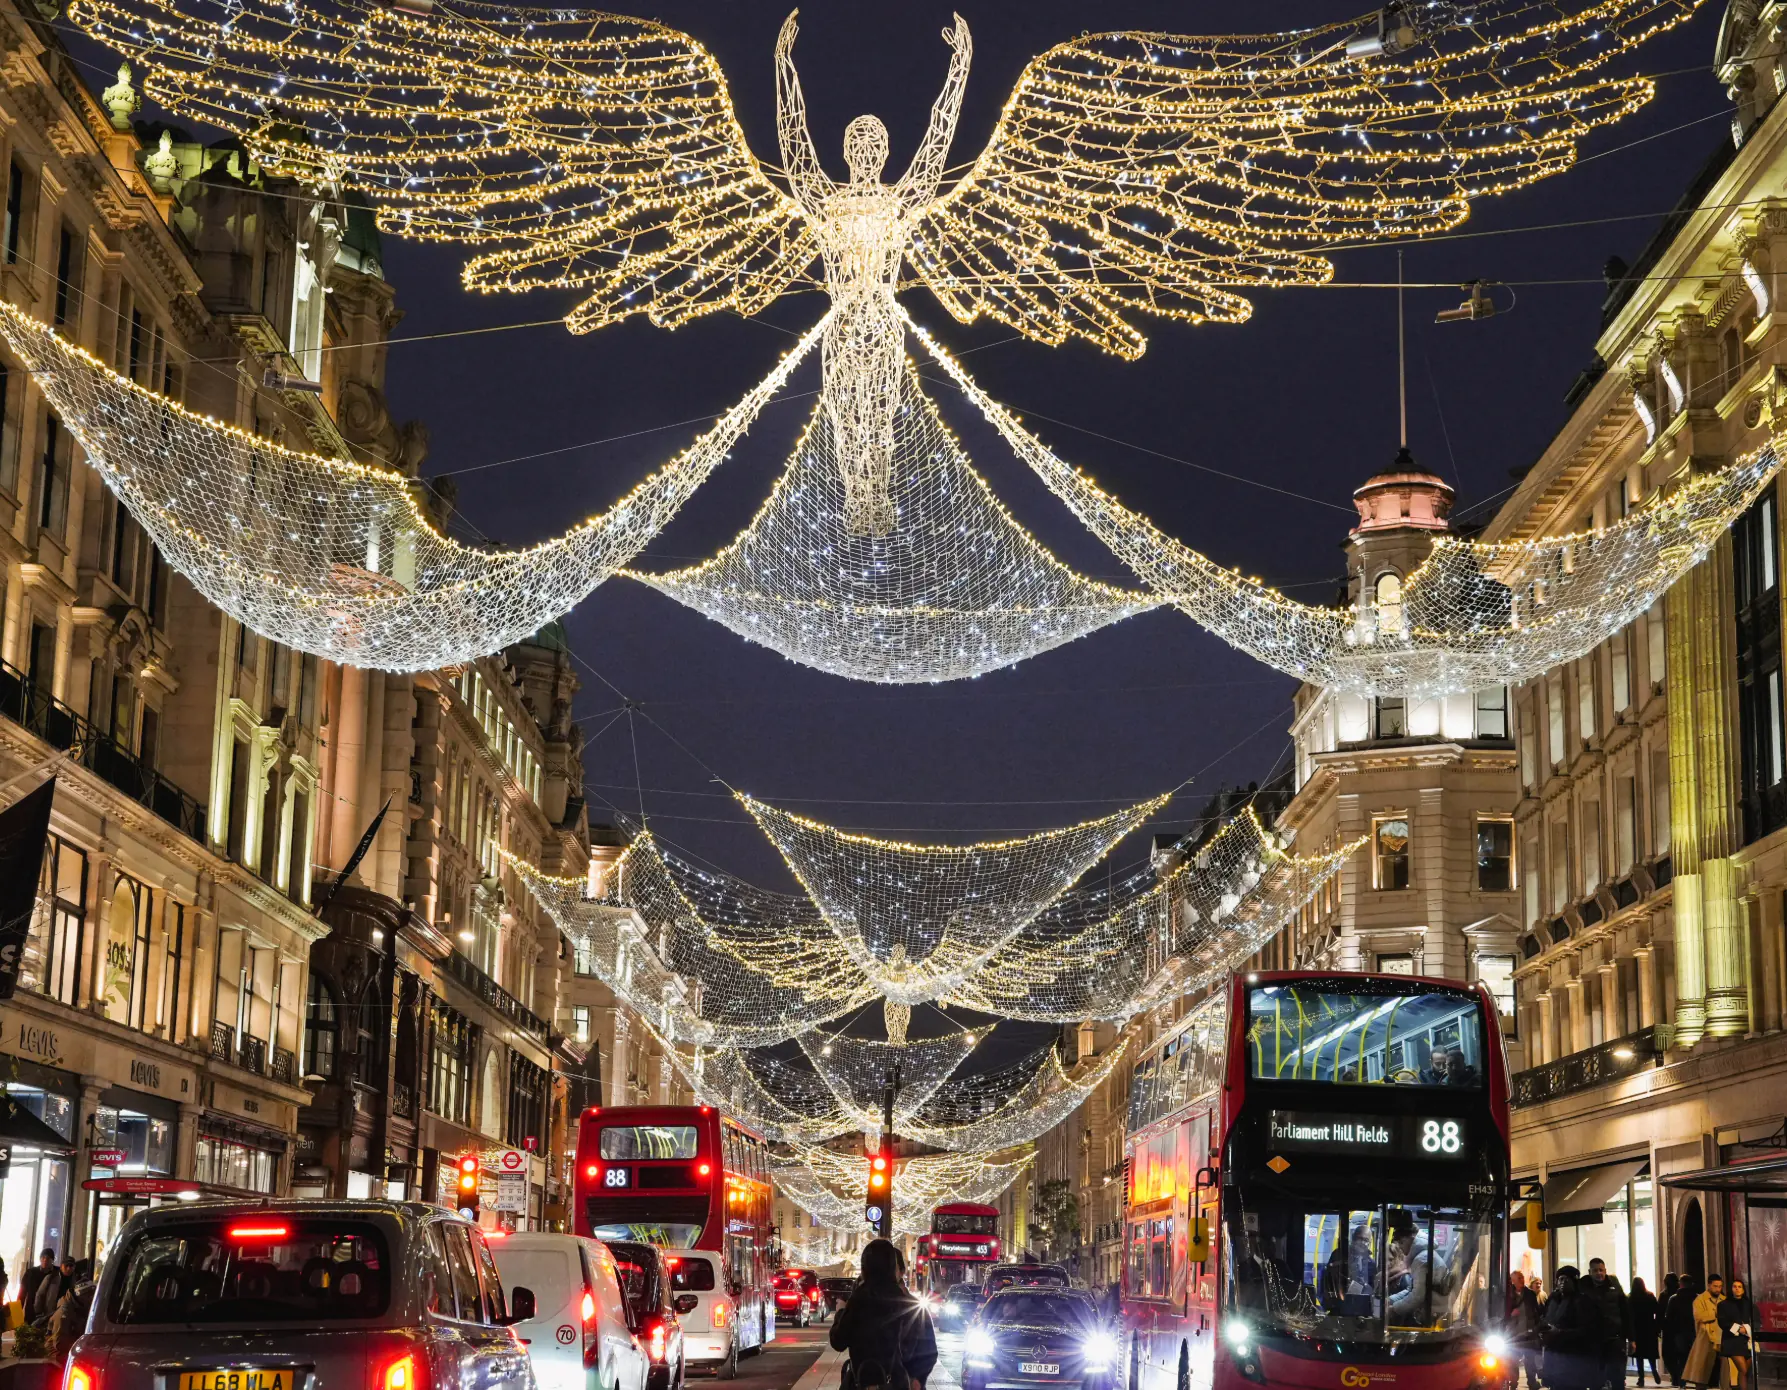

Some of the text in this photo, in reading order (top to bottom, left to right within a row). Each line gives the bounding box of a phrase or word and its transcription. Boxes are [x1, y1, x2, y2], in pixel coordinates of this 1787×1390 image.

[526, 1138, 535, 1148] T
[1271, 1120, 1460, 1153] Parliament Hill Fields 88
[606, 1169, 626, 1186] 88
[560, 1329, 573, 1341] 70
[188, 1374, 240, 1390] LL68
